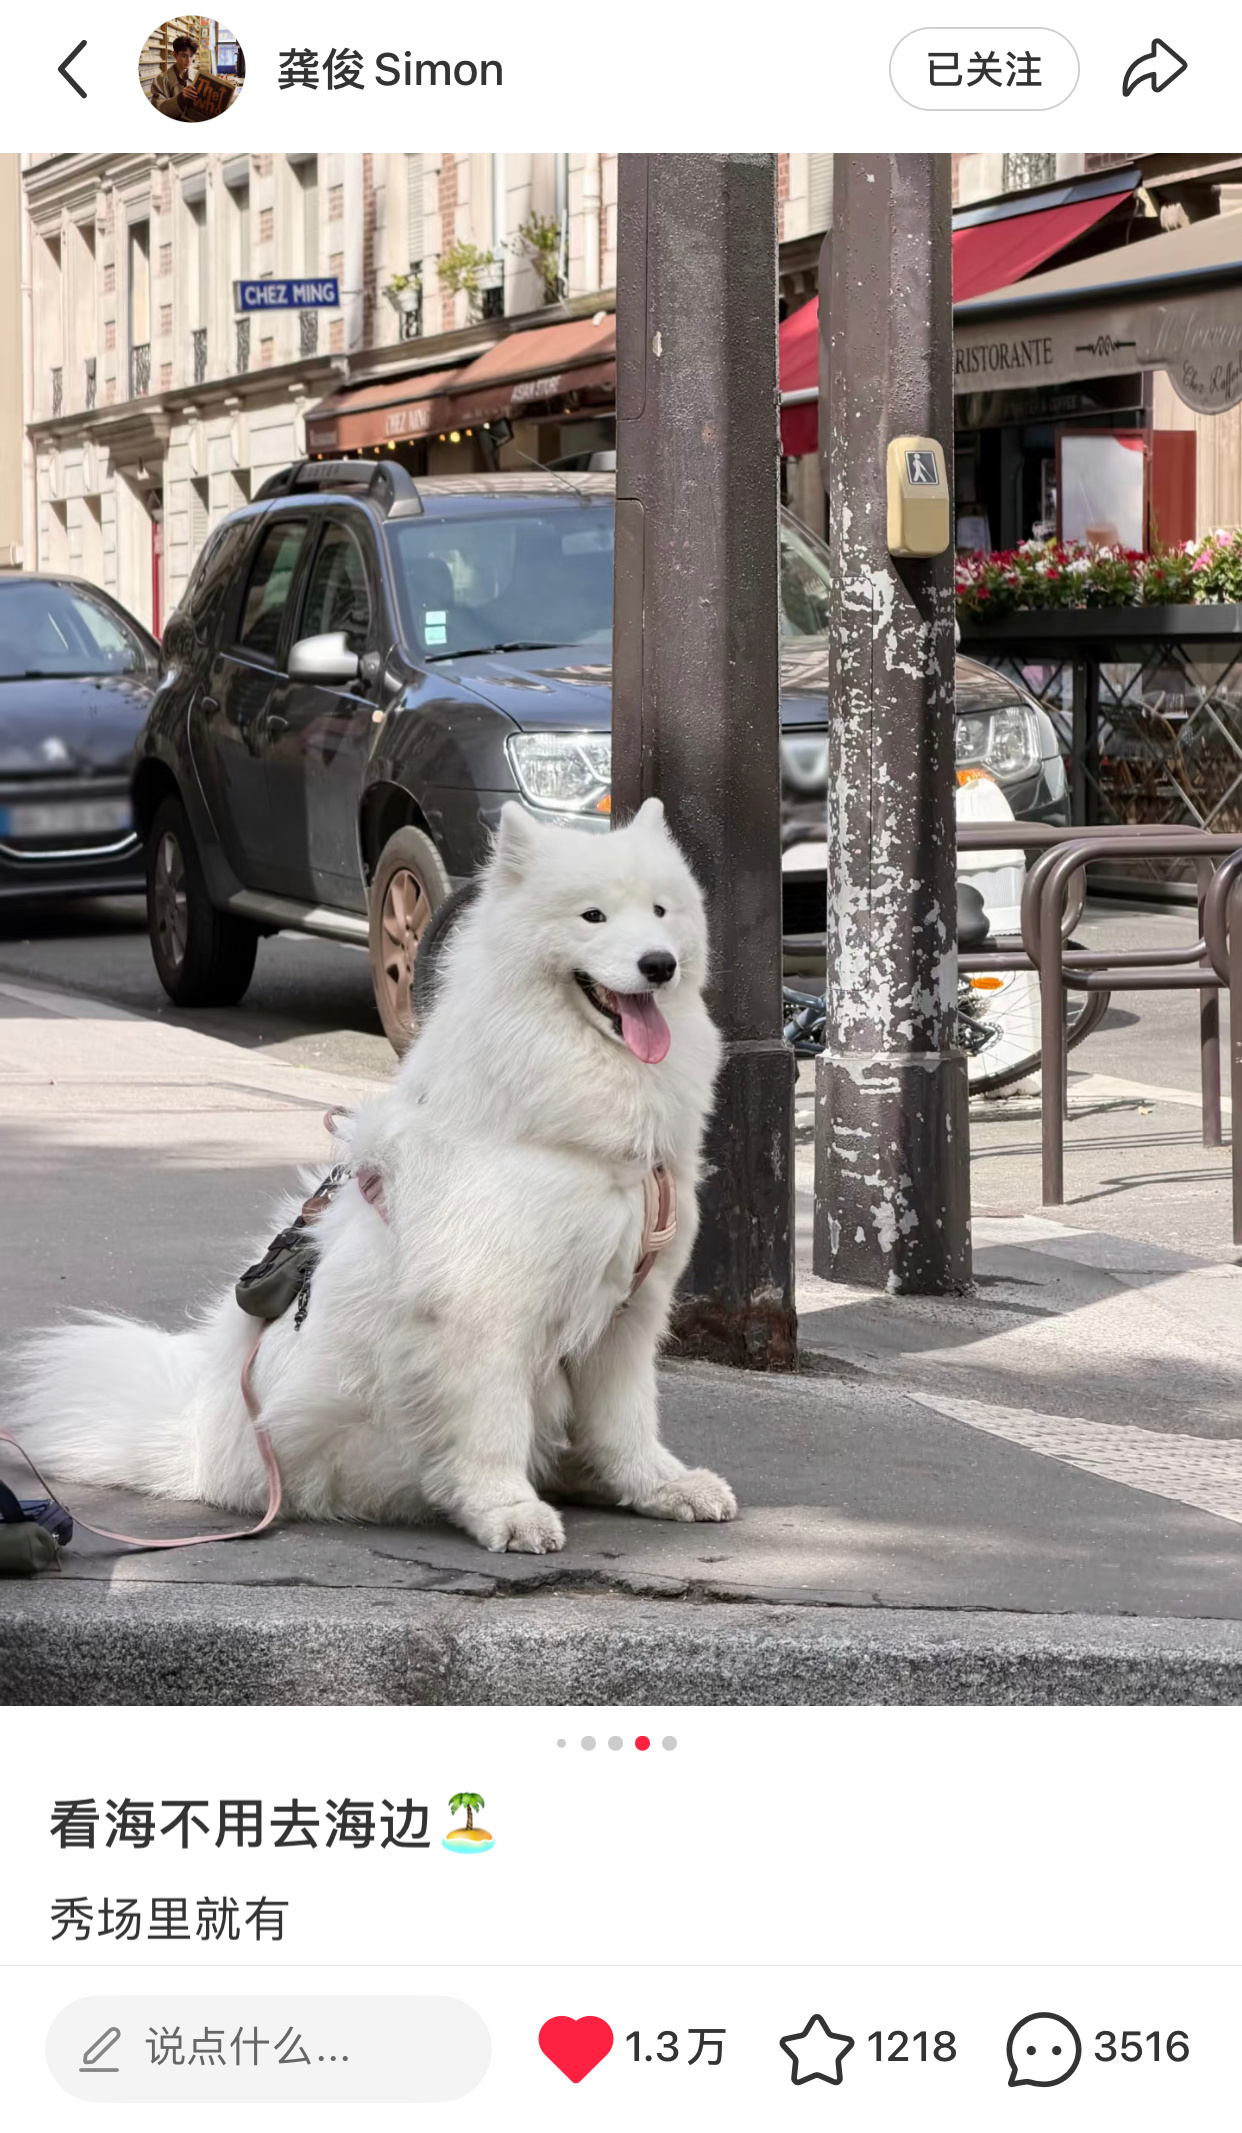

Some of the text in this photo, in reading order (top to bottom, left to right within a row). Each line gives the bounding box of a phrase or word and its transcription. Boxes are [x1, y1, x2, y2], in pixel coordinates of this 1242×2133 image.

[244, 282, 335, 305] CHEZ MING
[954, 338, 1053, 374] RISTORANTE
[385, 406, 431, 437] CHEZ MING
